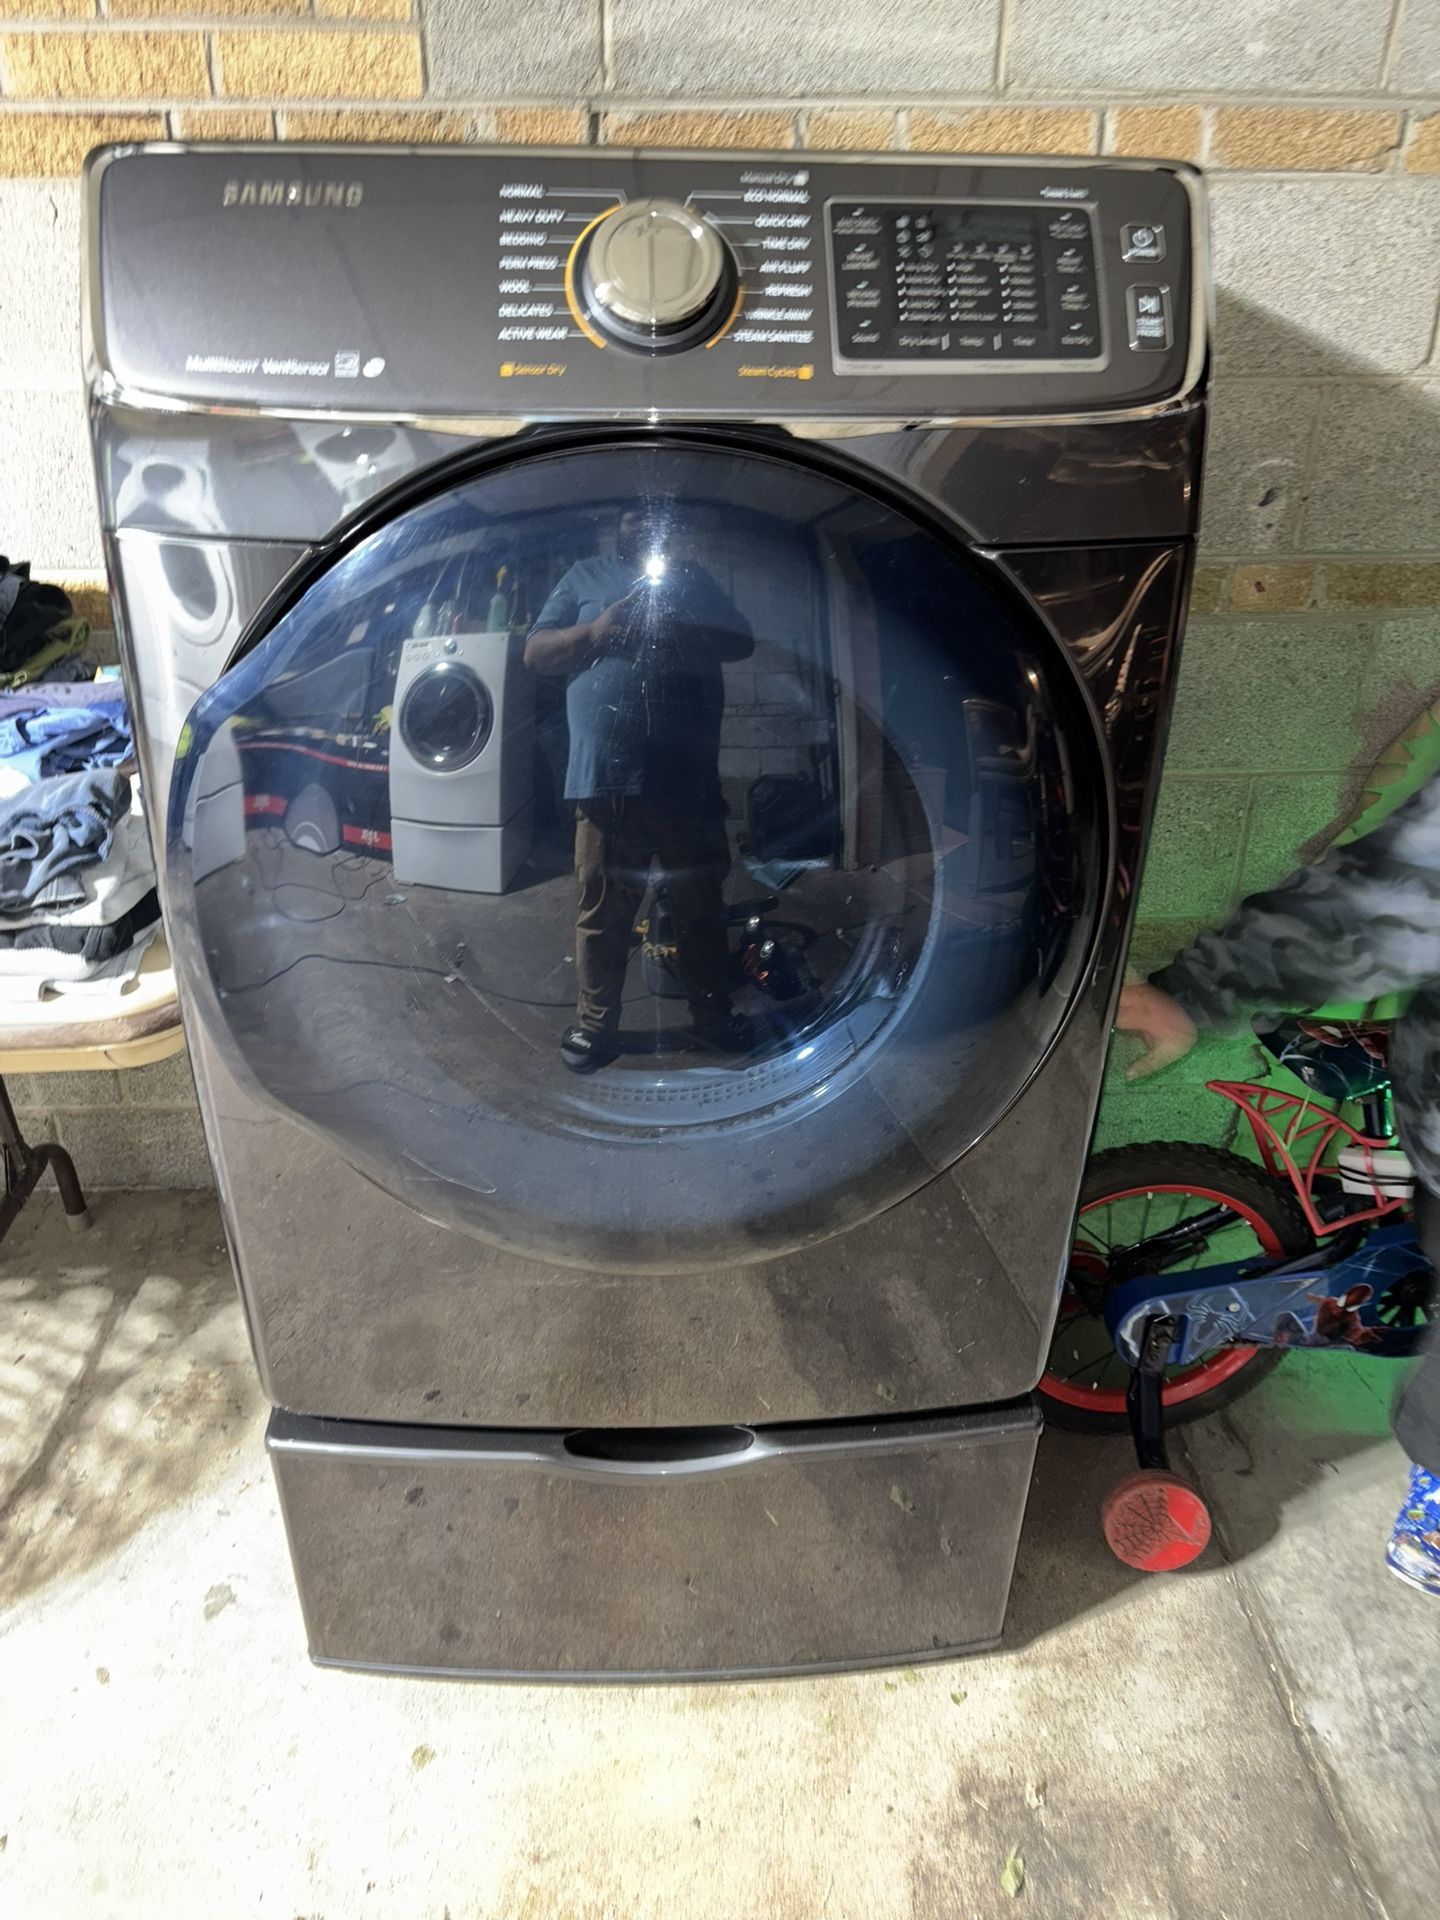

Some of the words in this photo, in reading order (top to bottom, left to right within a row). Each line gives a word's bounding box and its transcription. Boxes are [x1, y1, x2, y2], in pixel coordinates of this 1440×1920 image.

[223, 179, 363, 207] SAMSUNG
[499, 184, 545, 198] NORMAL
[744, 189, 766, 204] ECO
[766, 189, 811, 204] NORMAL
[499, 208, 535, 223] HEAVY
[535, 208, 565, 223] DUTY
[755, 213, 786, 228] QUICK
[786, 213, 811, 228] DRY
[499, 231, 547, 246] BEDDING
[762, 236, 787, 250] TIME
[787, 236, 811, 250] DRY
[499, 256, 527, 270] PERM
[528, 256, 559, 270] PRESS
[760, 260, 778, 274] AIR
[499, 280, 531, 293] WOOL
[765, 283, 813, 297] REFRESH
[499, 303, 554, 317] DELICATES
[498, 326, 534, 340] ACTIVE
[535, 326, 568, 340] WEAR
[734, 329, 769, 343] STEAM
[738, 364, 767, 378] Steam
[768, 364, 797, 378] Cycles
